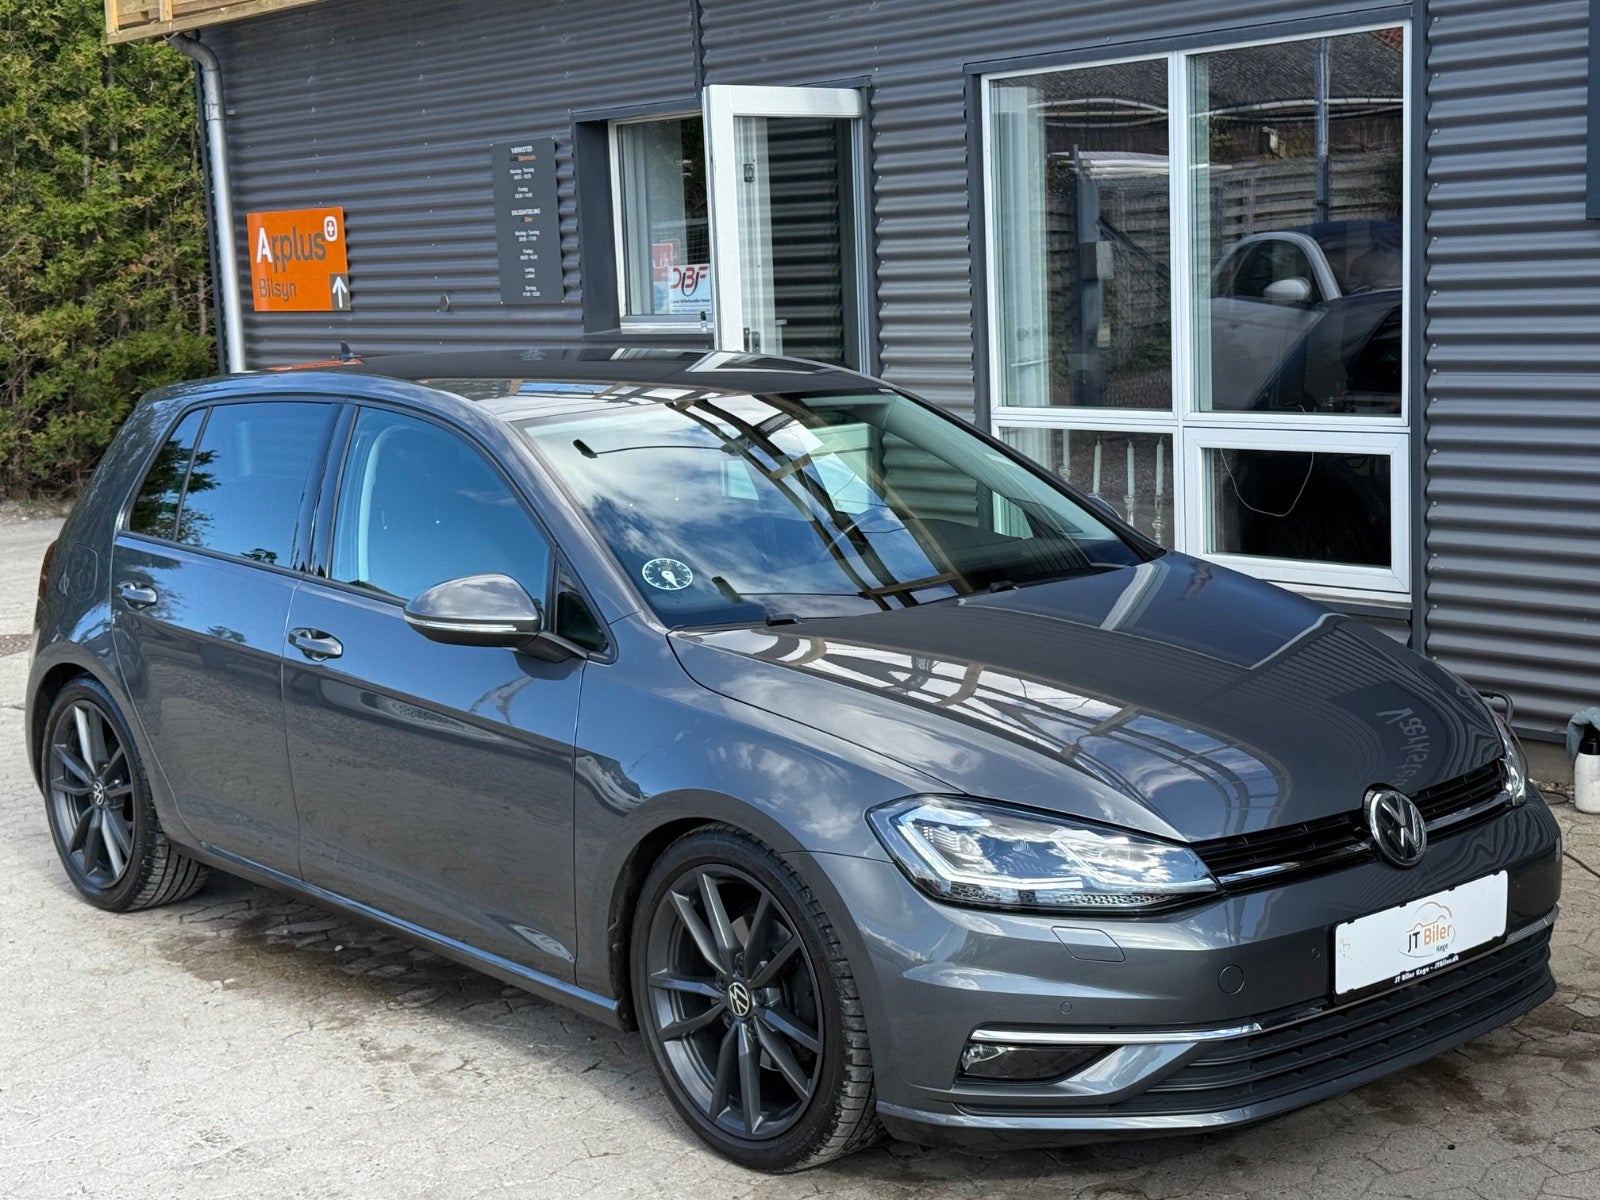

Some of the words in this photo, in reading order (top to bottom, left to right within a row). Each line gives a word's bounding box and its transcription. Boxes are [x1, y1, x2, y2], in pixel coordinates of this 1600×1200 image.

[258, 278, 297, 303] Bilsyn
[1407, 931, 1421, 953] JT
[1423, 921, 1453, 945] Biler
